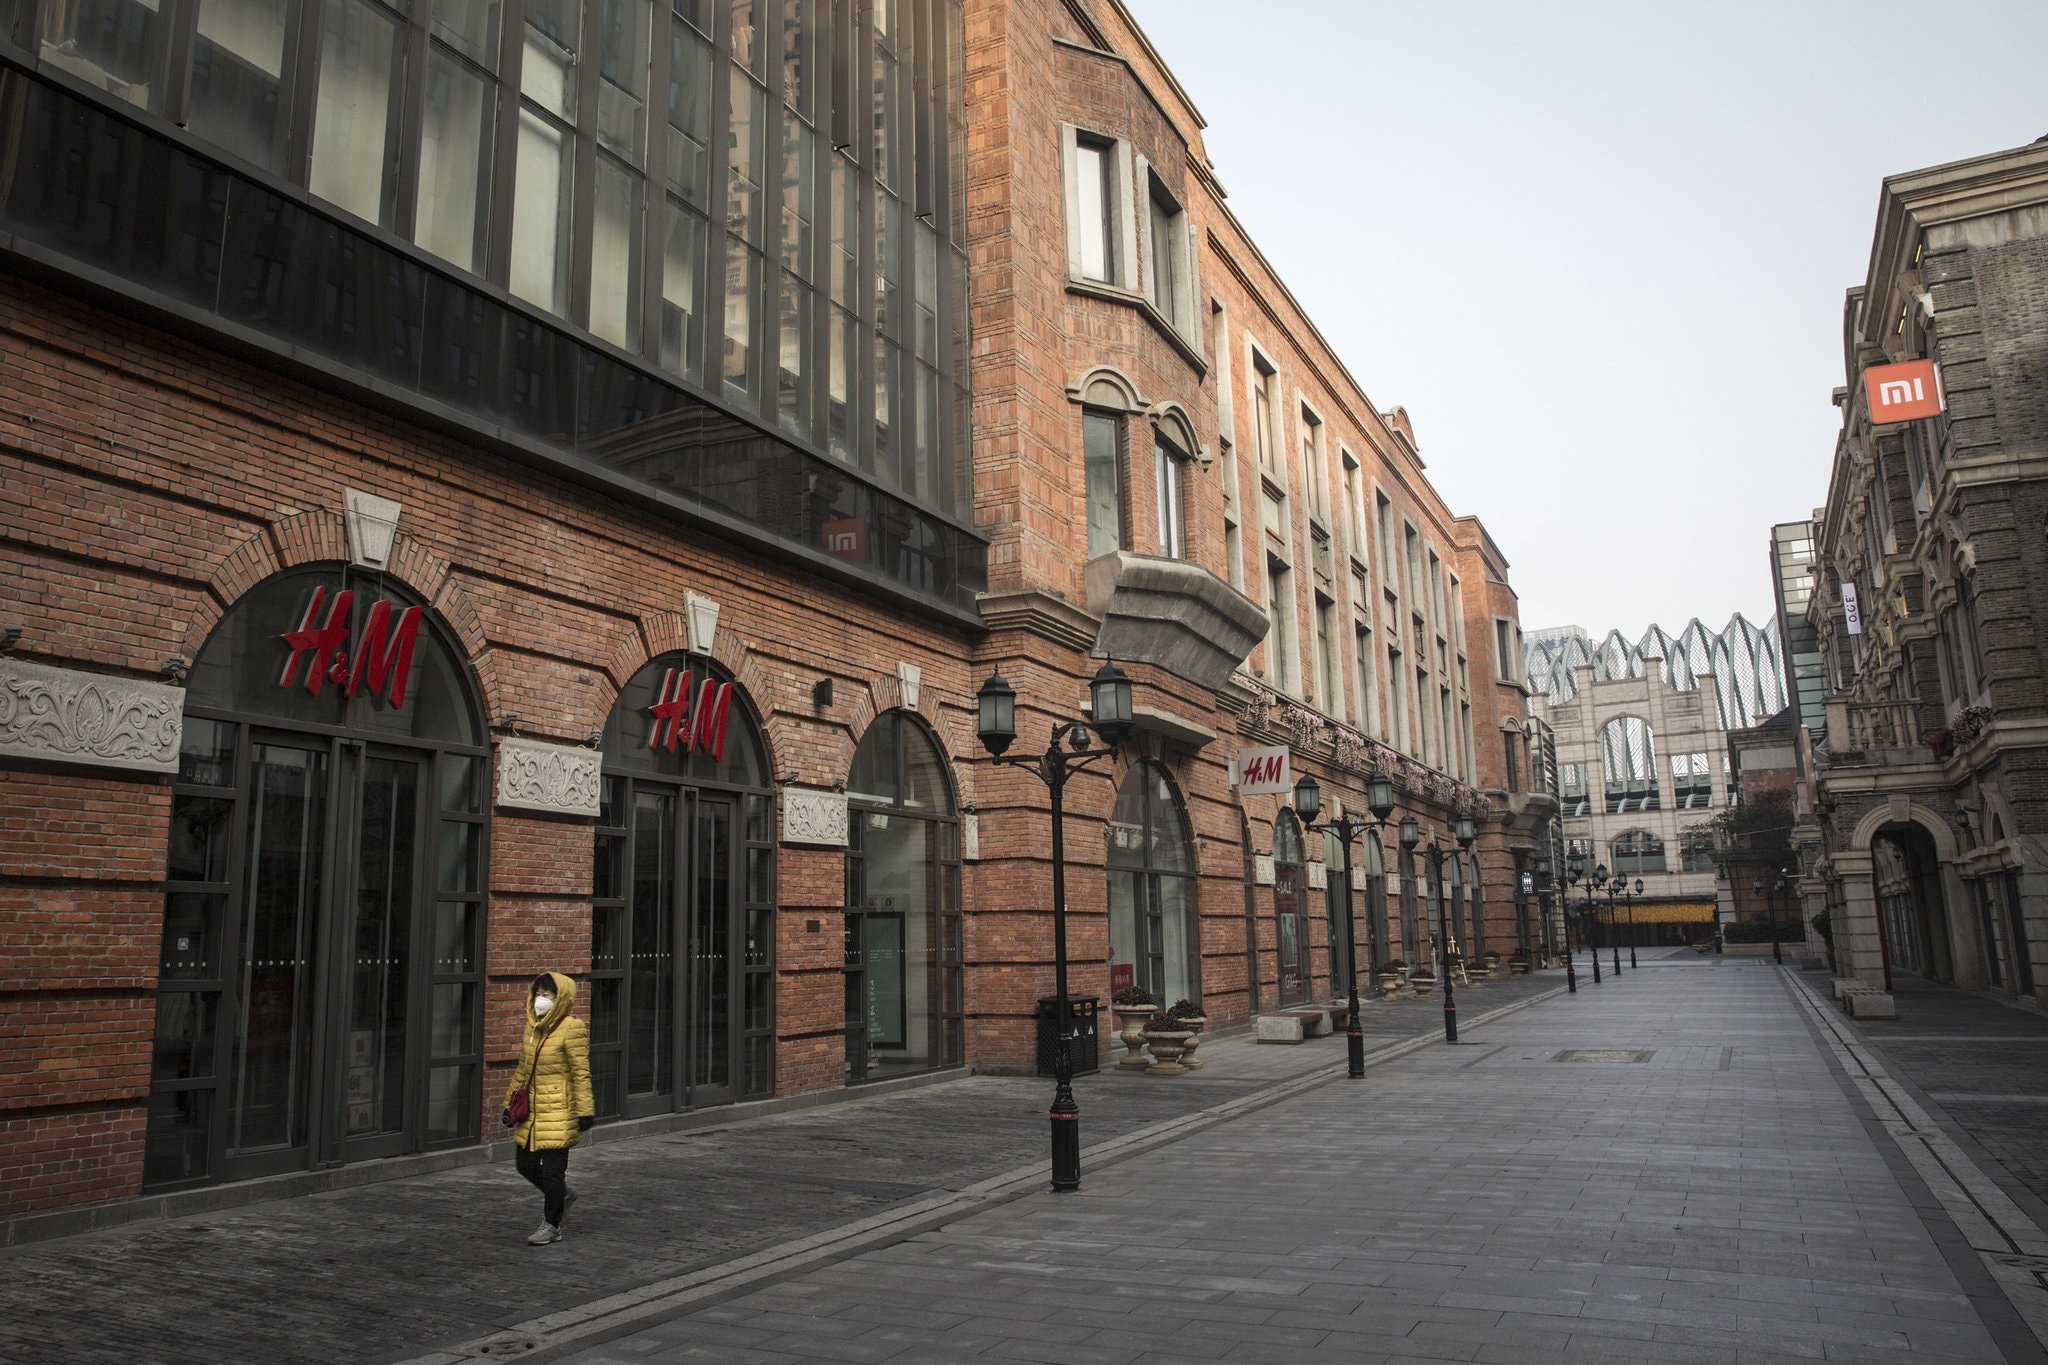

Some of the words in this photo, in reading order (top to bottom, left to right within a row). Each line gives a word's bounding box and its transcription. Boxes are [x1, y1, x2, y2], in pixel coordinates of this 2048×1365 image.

[279, 584, 423, 710] H&M
[648, 667, 733, 763] H&M
[1243, 755, 1284, 785] H&M
[870, 1005, 876, 1016] 2
